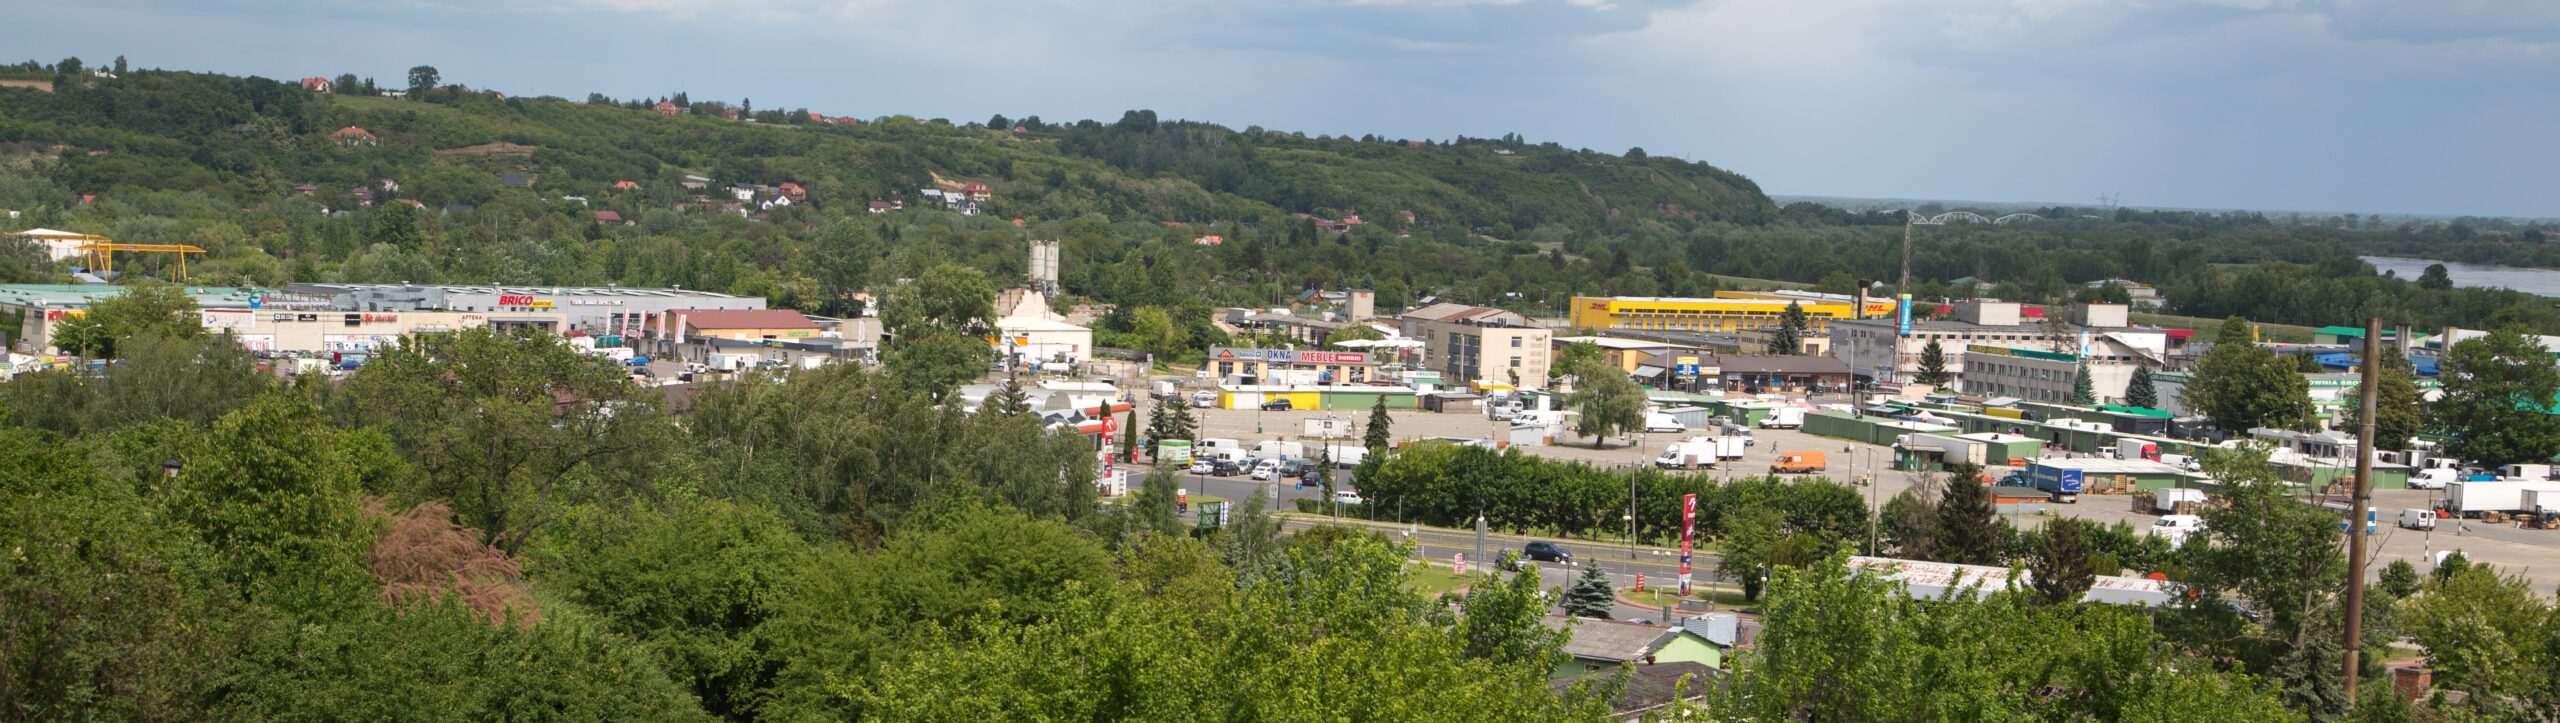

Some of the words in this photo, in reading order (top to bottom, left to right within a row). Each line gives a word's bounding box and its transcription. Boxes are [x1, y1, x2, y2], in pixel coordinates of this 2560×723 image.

[499, 295, 533, 305] BRICO
[1589, 303, 1608, 311] DHL
[1267, 349, 1291, 360] OKNA
[1301, 352, 1334, 362] MEBLE
